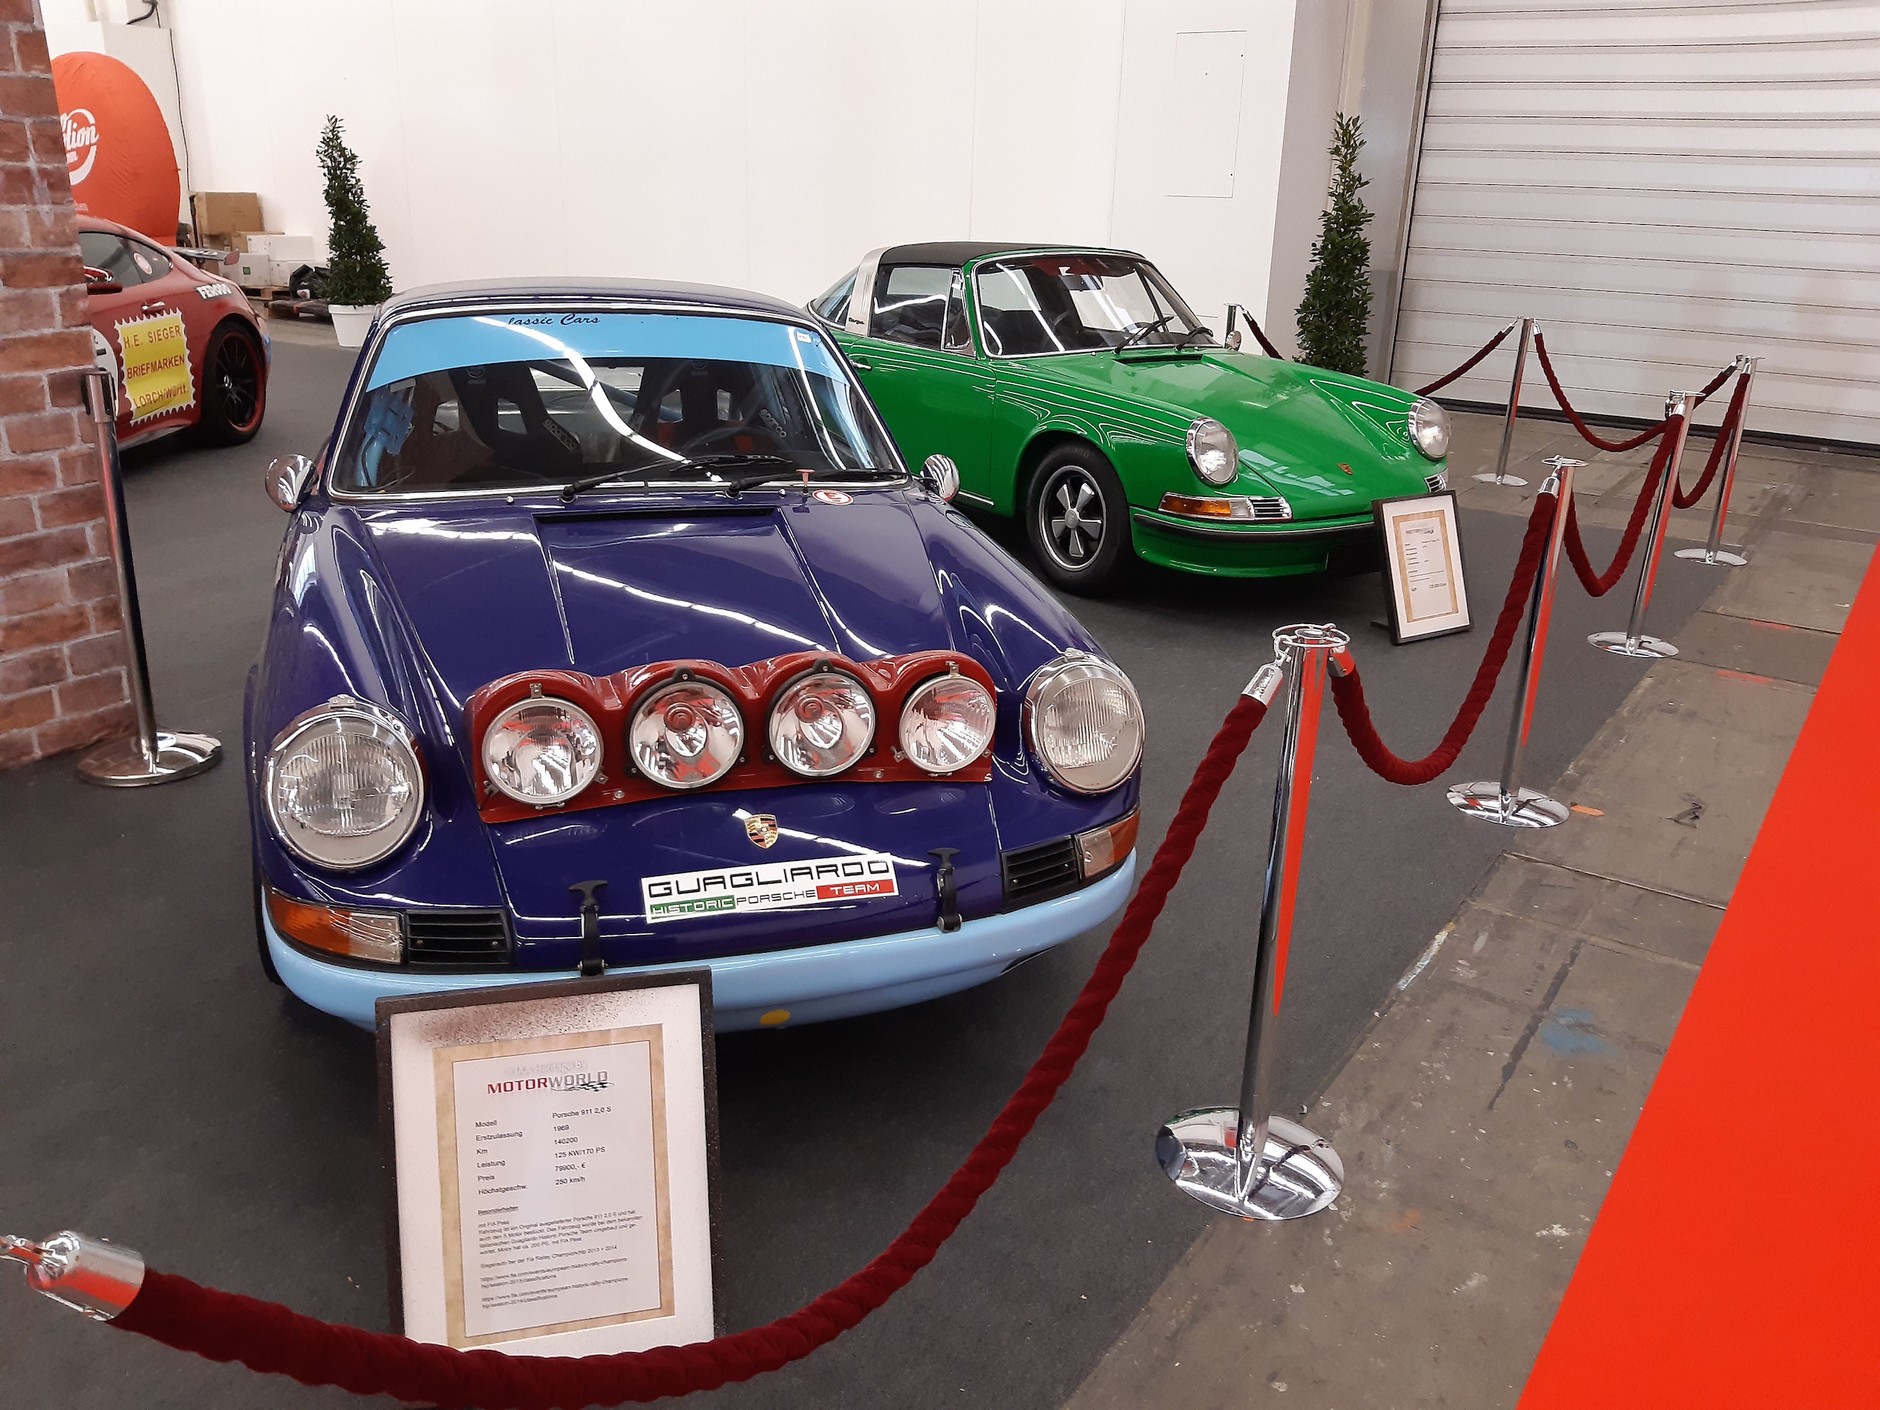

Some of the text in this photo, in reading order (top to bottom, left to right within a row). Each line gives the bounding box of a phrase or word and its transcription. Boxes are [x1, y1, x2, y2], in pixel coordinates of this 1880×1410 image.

[560, 312, 601, 326] Cars
[123, 325, 182, 349] H.E. SIEGER
[126, 354, 185, 380] BRIEFMARKEN
[648, 859, 890, 898] GUAGLIARDO
[651, 882, 881, 915] HISTORIC PORSCHE TEAM
[487, 1070, 608, 1095] MOTORWORLD
[552, 1111, 579, 1119] Porsche
[475, 1119, 497, 1128] Modell
[476, 1131, 523, 1142] Erstzulassung
[477, 1160, 506, 1168] Leistung
[555, 1177, 568, 1185] 250
